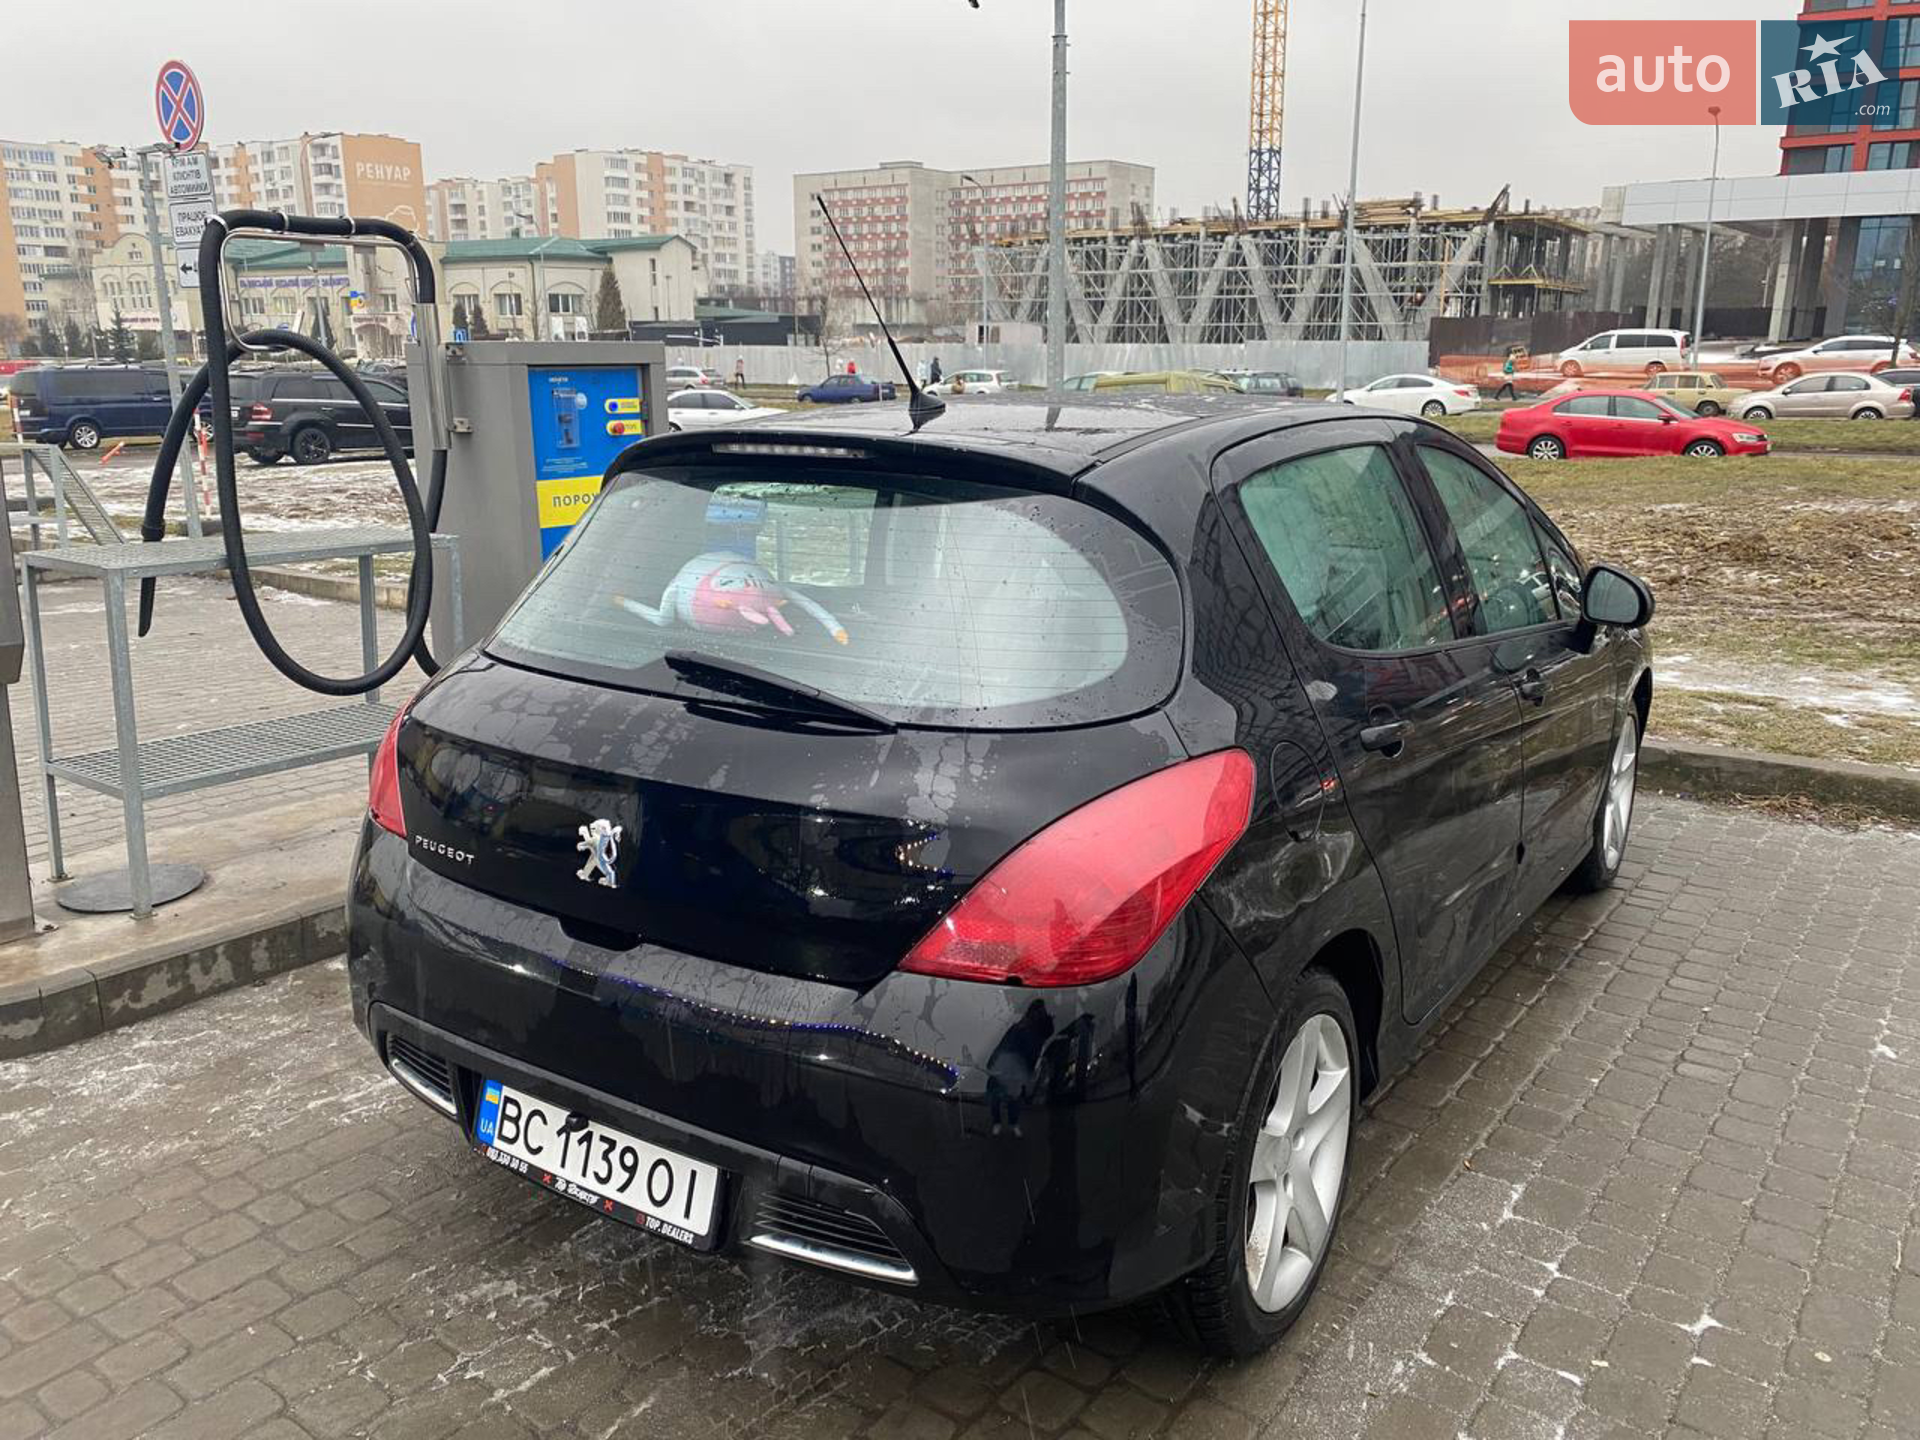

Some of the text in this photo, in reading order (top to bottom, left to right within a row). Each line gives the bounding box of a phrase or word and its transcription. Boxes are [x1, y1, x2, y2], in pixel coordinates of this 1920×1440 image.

[356, 162, 411, 181] РЕНУАР
[415, 834, 475, 865] PEUGEOT
[480, 1120, 494, 1136] UA
[497, 1095, 549, 1156] BC
[556, 1121, 640, 1194] 1139
